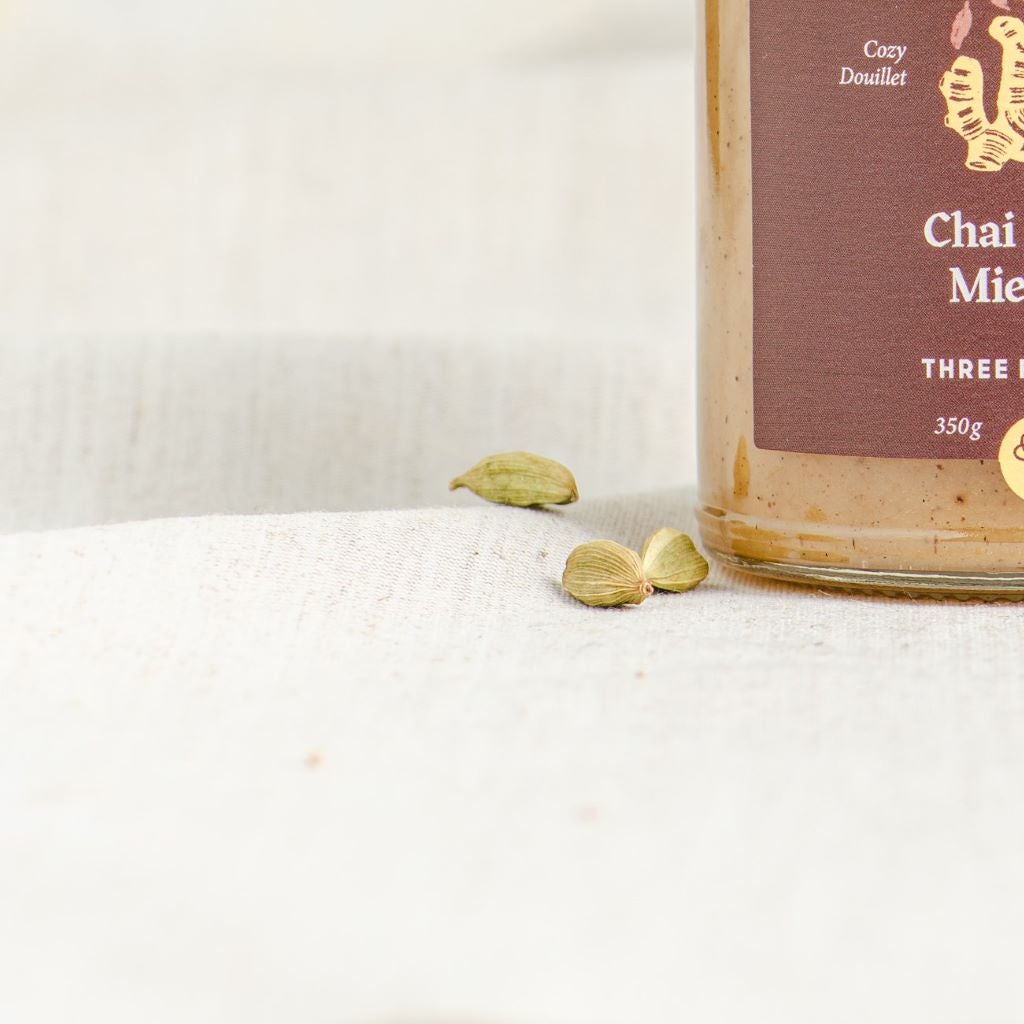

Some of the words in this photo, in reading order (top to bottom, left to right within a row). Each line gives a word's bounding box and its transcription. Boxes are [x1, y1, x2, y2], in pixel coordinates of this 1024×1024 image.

[863, 38, 907, 65] Cozy
[838, 65, 908, 87] Douillet
[923, 210, 1017, 249] Chai
[921, 357, 1009, 381] THREE
[933, 416, 983, 442] 350g
